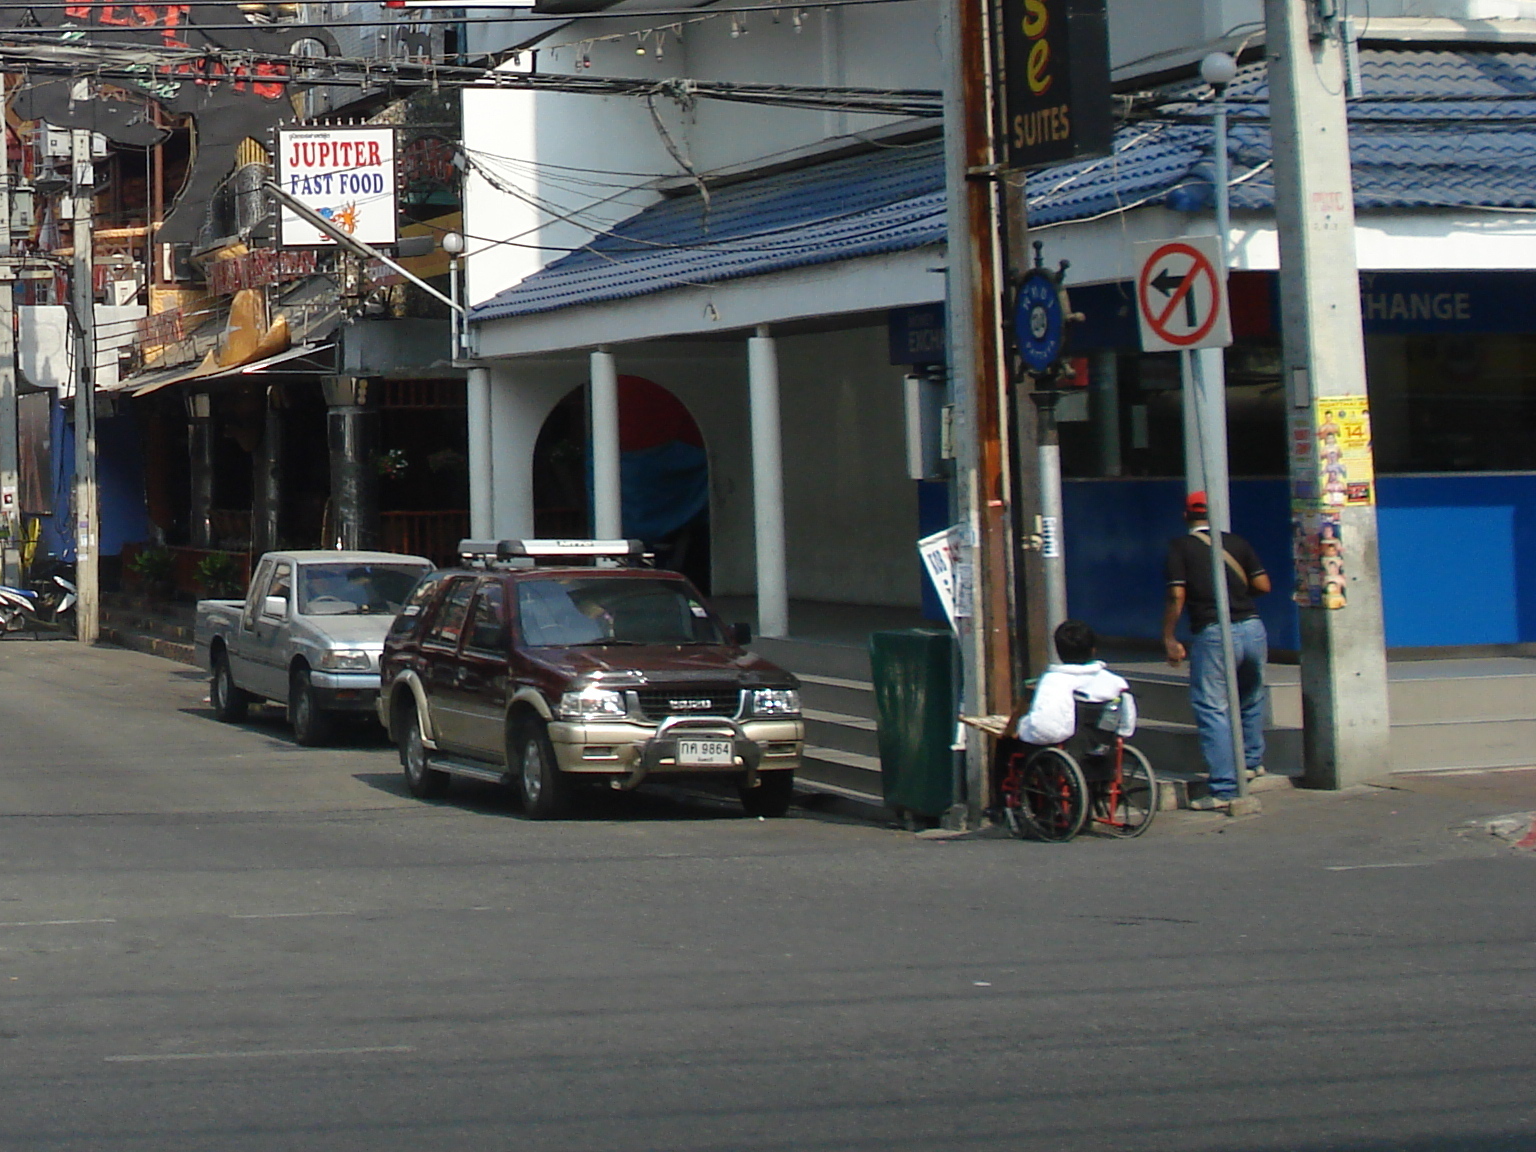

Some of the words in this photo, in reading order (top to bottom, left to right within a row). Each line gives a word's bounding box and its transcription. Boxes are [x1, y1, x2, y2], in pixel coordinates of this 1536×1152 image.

[1013, 104, 1070, 149] SUITES
[289, 140, 382, 168] JUPITER
[290, 174, 333, 195] FAST
[339, 173, 384, 195] FOOD
[1361, 292, 1470, 320] HANGE
[701, 743, 729, 755] 9864
